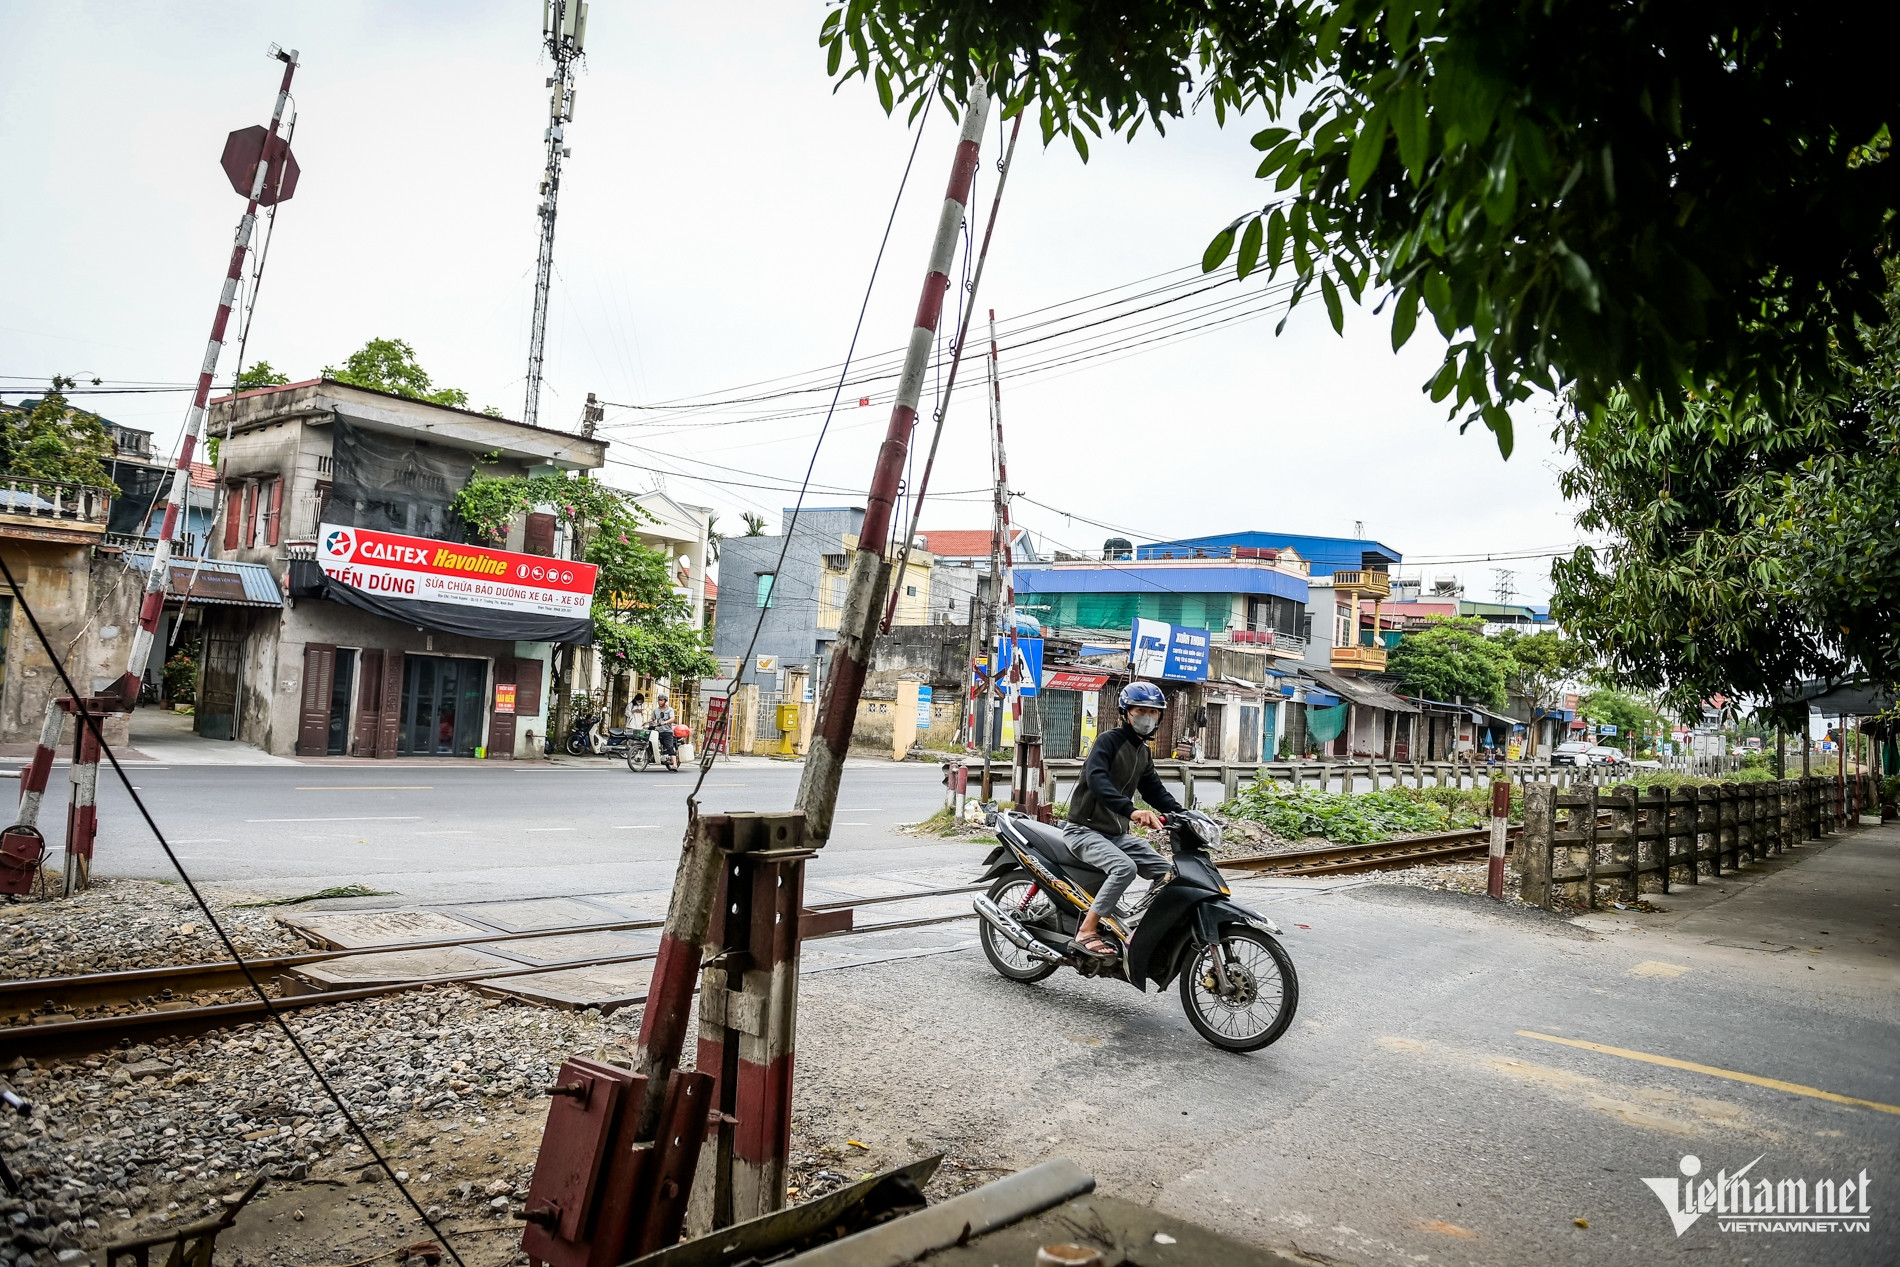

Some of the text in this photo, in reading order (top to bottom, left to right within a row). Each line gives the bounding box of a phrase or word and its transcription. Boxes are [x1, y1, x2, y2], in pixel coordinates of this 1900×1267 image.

[360, 541, 508, 576] CALTEX Havoline
[369, 573, 415, 594] DŨNG
[425, 576, 444, 589] SỬA
[447, 581, 472, 593] CHỮA
[475, 583, 493, 595] BẢO
[496, 587, 526, 599] DƯỠNG
[528, 591, 540, 601] XE
[542, 593, 553, 602] GA
[561, 595, 572, 604] XE
[573, 595, 586, 606] SỐ
